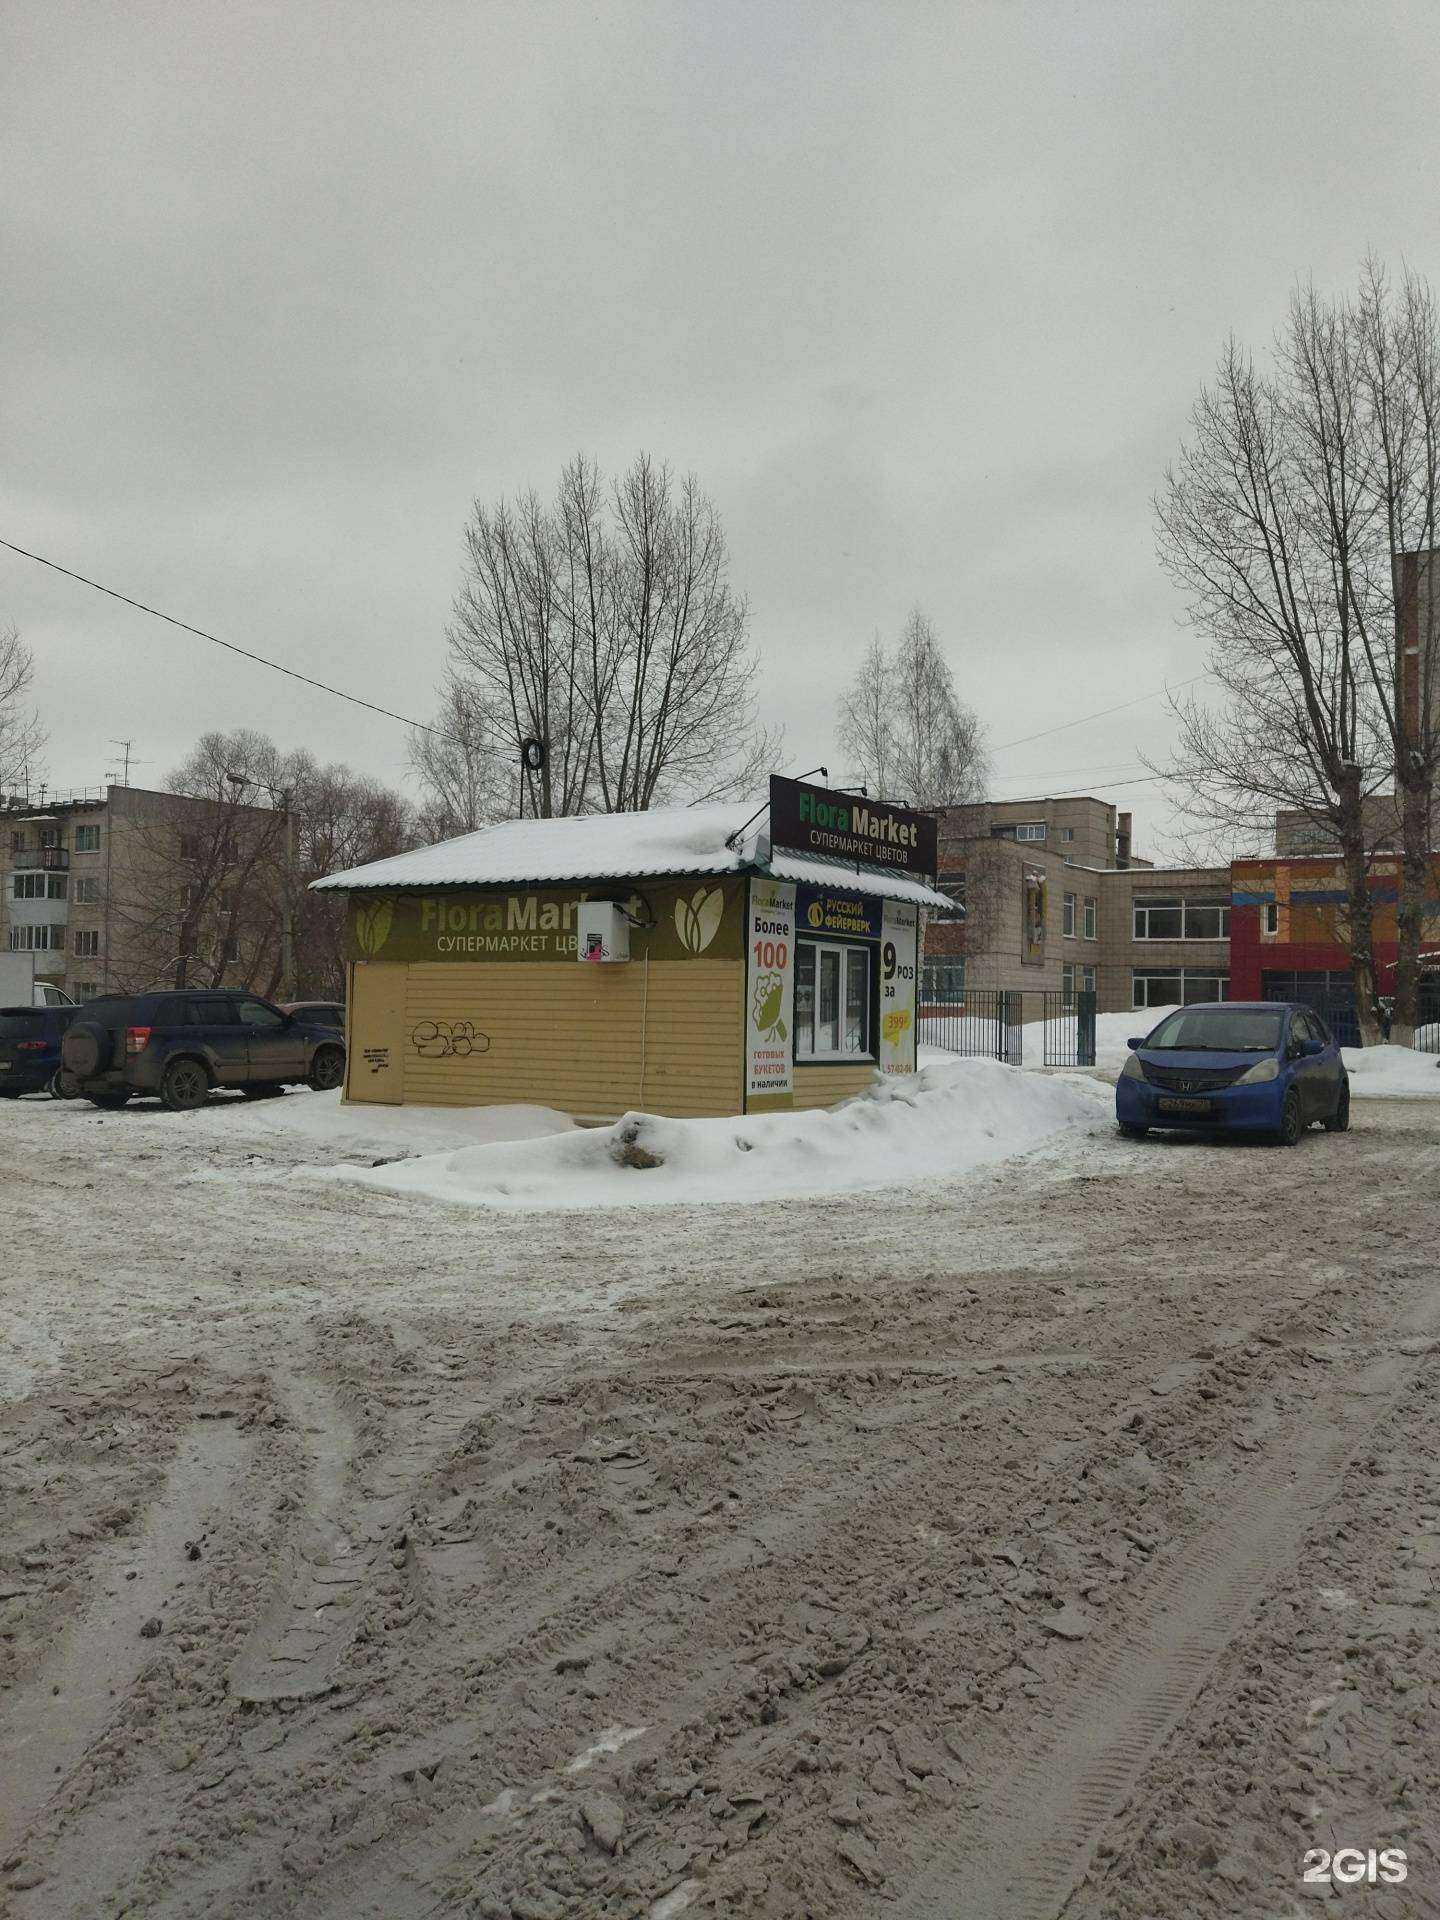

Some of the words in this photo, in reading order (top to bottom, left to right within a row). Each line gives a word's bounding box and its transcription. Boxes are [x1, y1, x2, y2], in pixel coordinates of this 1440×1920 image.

[810, 830, 873, 856] СУПЕРМАРКЕТ
[875, 844, 908, 864] ЦВЕТОВ
[826, 898, 864, 916] РУССКИЙ
[754, 917, 790, 936] Более
[825, 918, 871, 933] ФЕЙЕРВЕРК
[437, 936, 548, 952] СУПЕРМАРКЕТ
[753, 940, 789, 970] 100
[883, 941, 897, 981] 9
[884, 986, 896, 998] за
[753, 1063, 786, 1075] БУКЕТОВ
[757, 1079, 789, 1089] наличии
